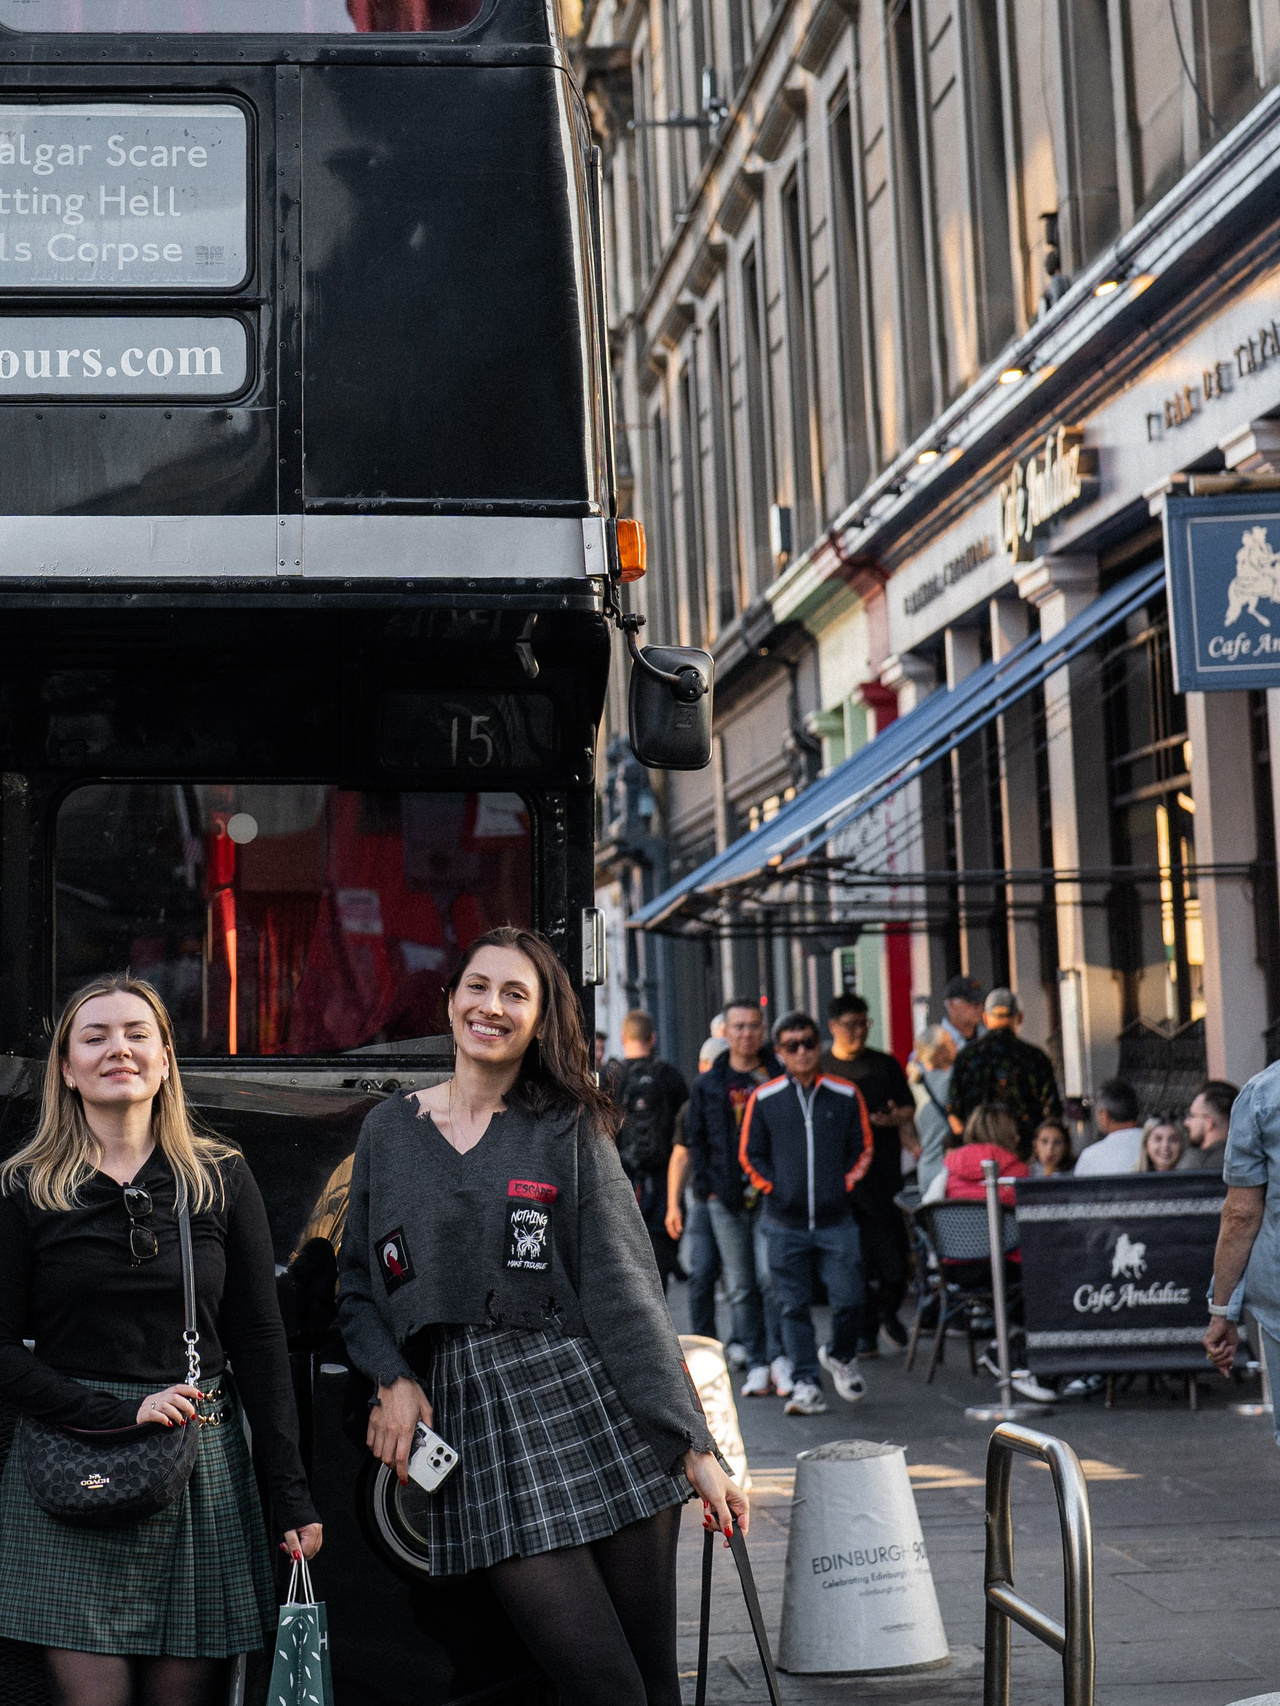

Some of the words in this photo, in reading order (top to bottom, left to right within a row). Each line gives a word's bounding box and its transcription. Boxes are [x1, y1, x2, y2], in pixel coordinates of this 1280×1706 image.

[107, 136, 209, 168] Scare
[100, 185, 181, 217] Hell
[47, 234, 183, 270] Corpse
[1208, 631, 1252, 661] Cafe
[450, 715, 494, 768] 15
[510, 1209, 549, 1227] NOTHING
[1073, 1283, 1116, 1313] Cafe
[1111, 1281, 1191, 1311] Andaluz
[80, 1477, 110, 1486] COACH
